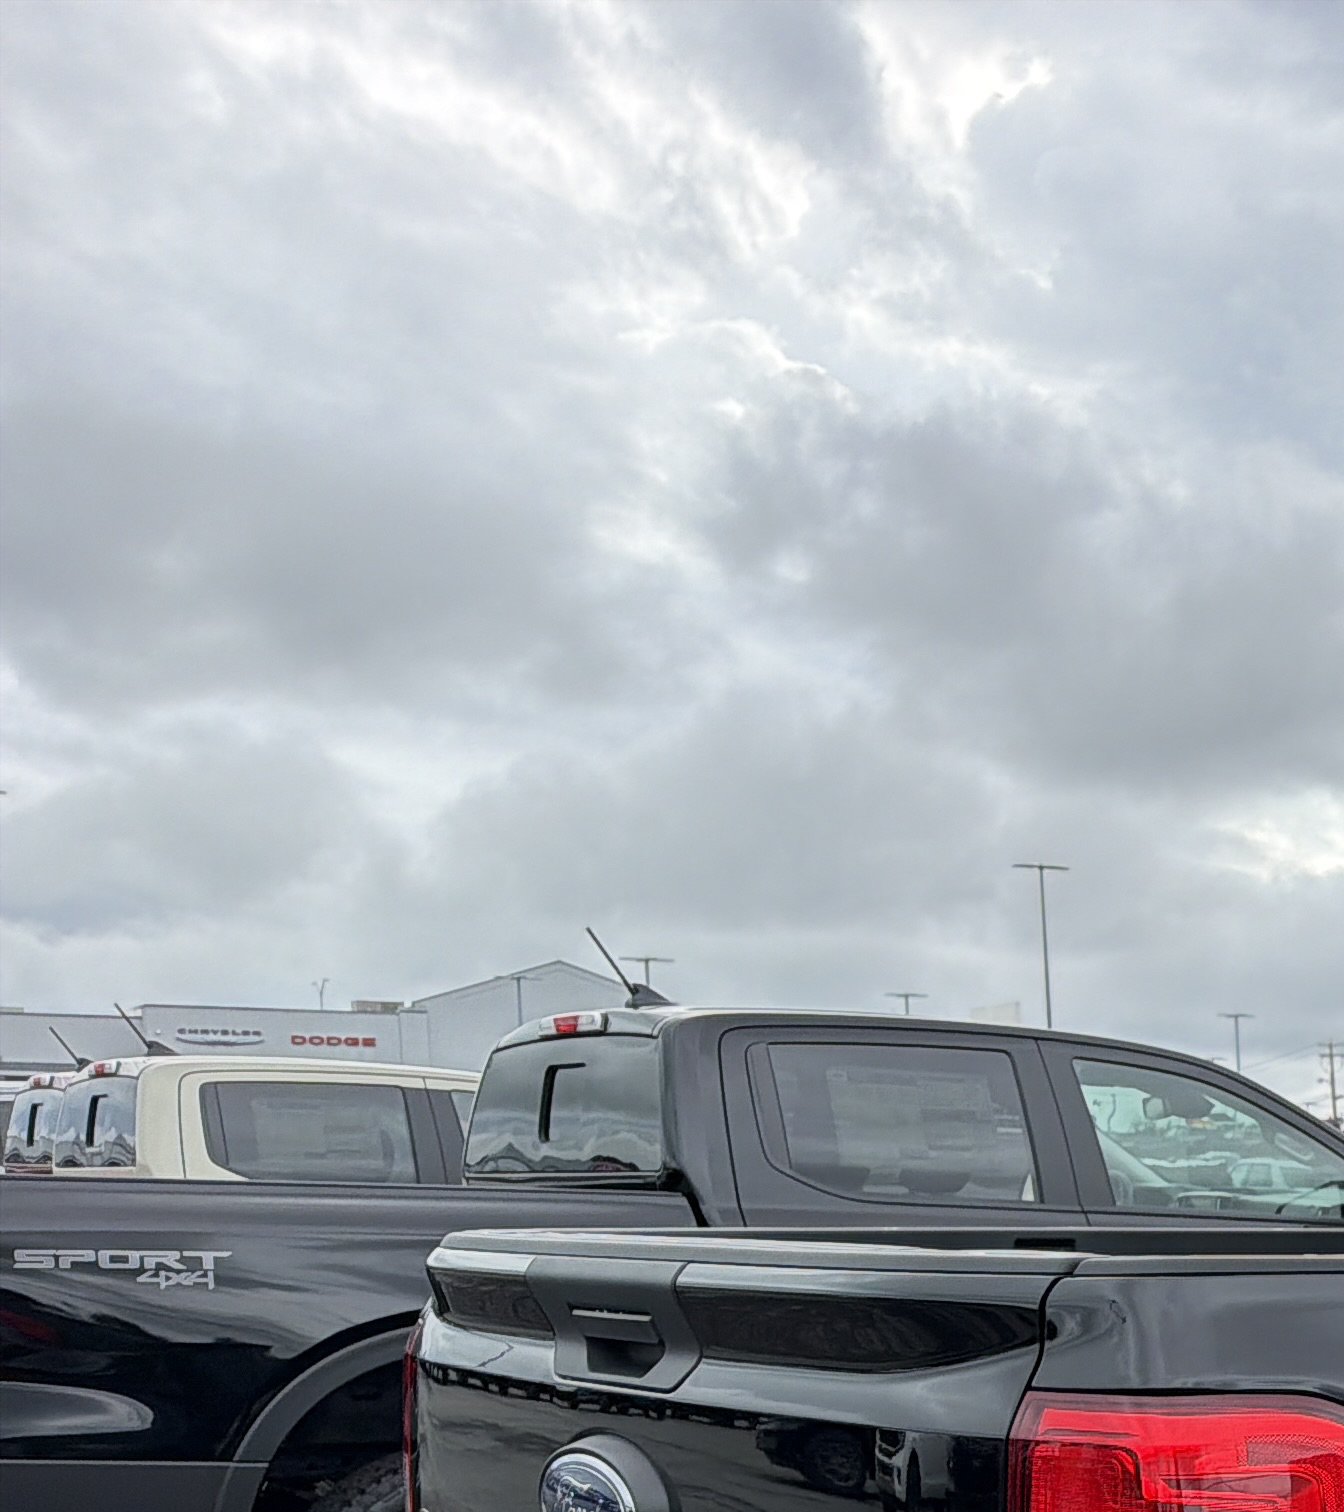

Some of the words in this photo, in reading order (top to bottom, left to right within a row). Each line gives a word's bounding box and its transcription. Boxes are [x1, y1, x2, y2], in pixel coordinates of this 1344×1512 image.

[177, 1028, 262, 1037] CHRYSLER
[291, 1035, 377, 1048] DODGE
[13, 1249, 232, 1270] SPORT
